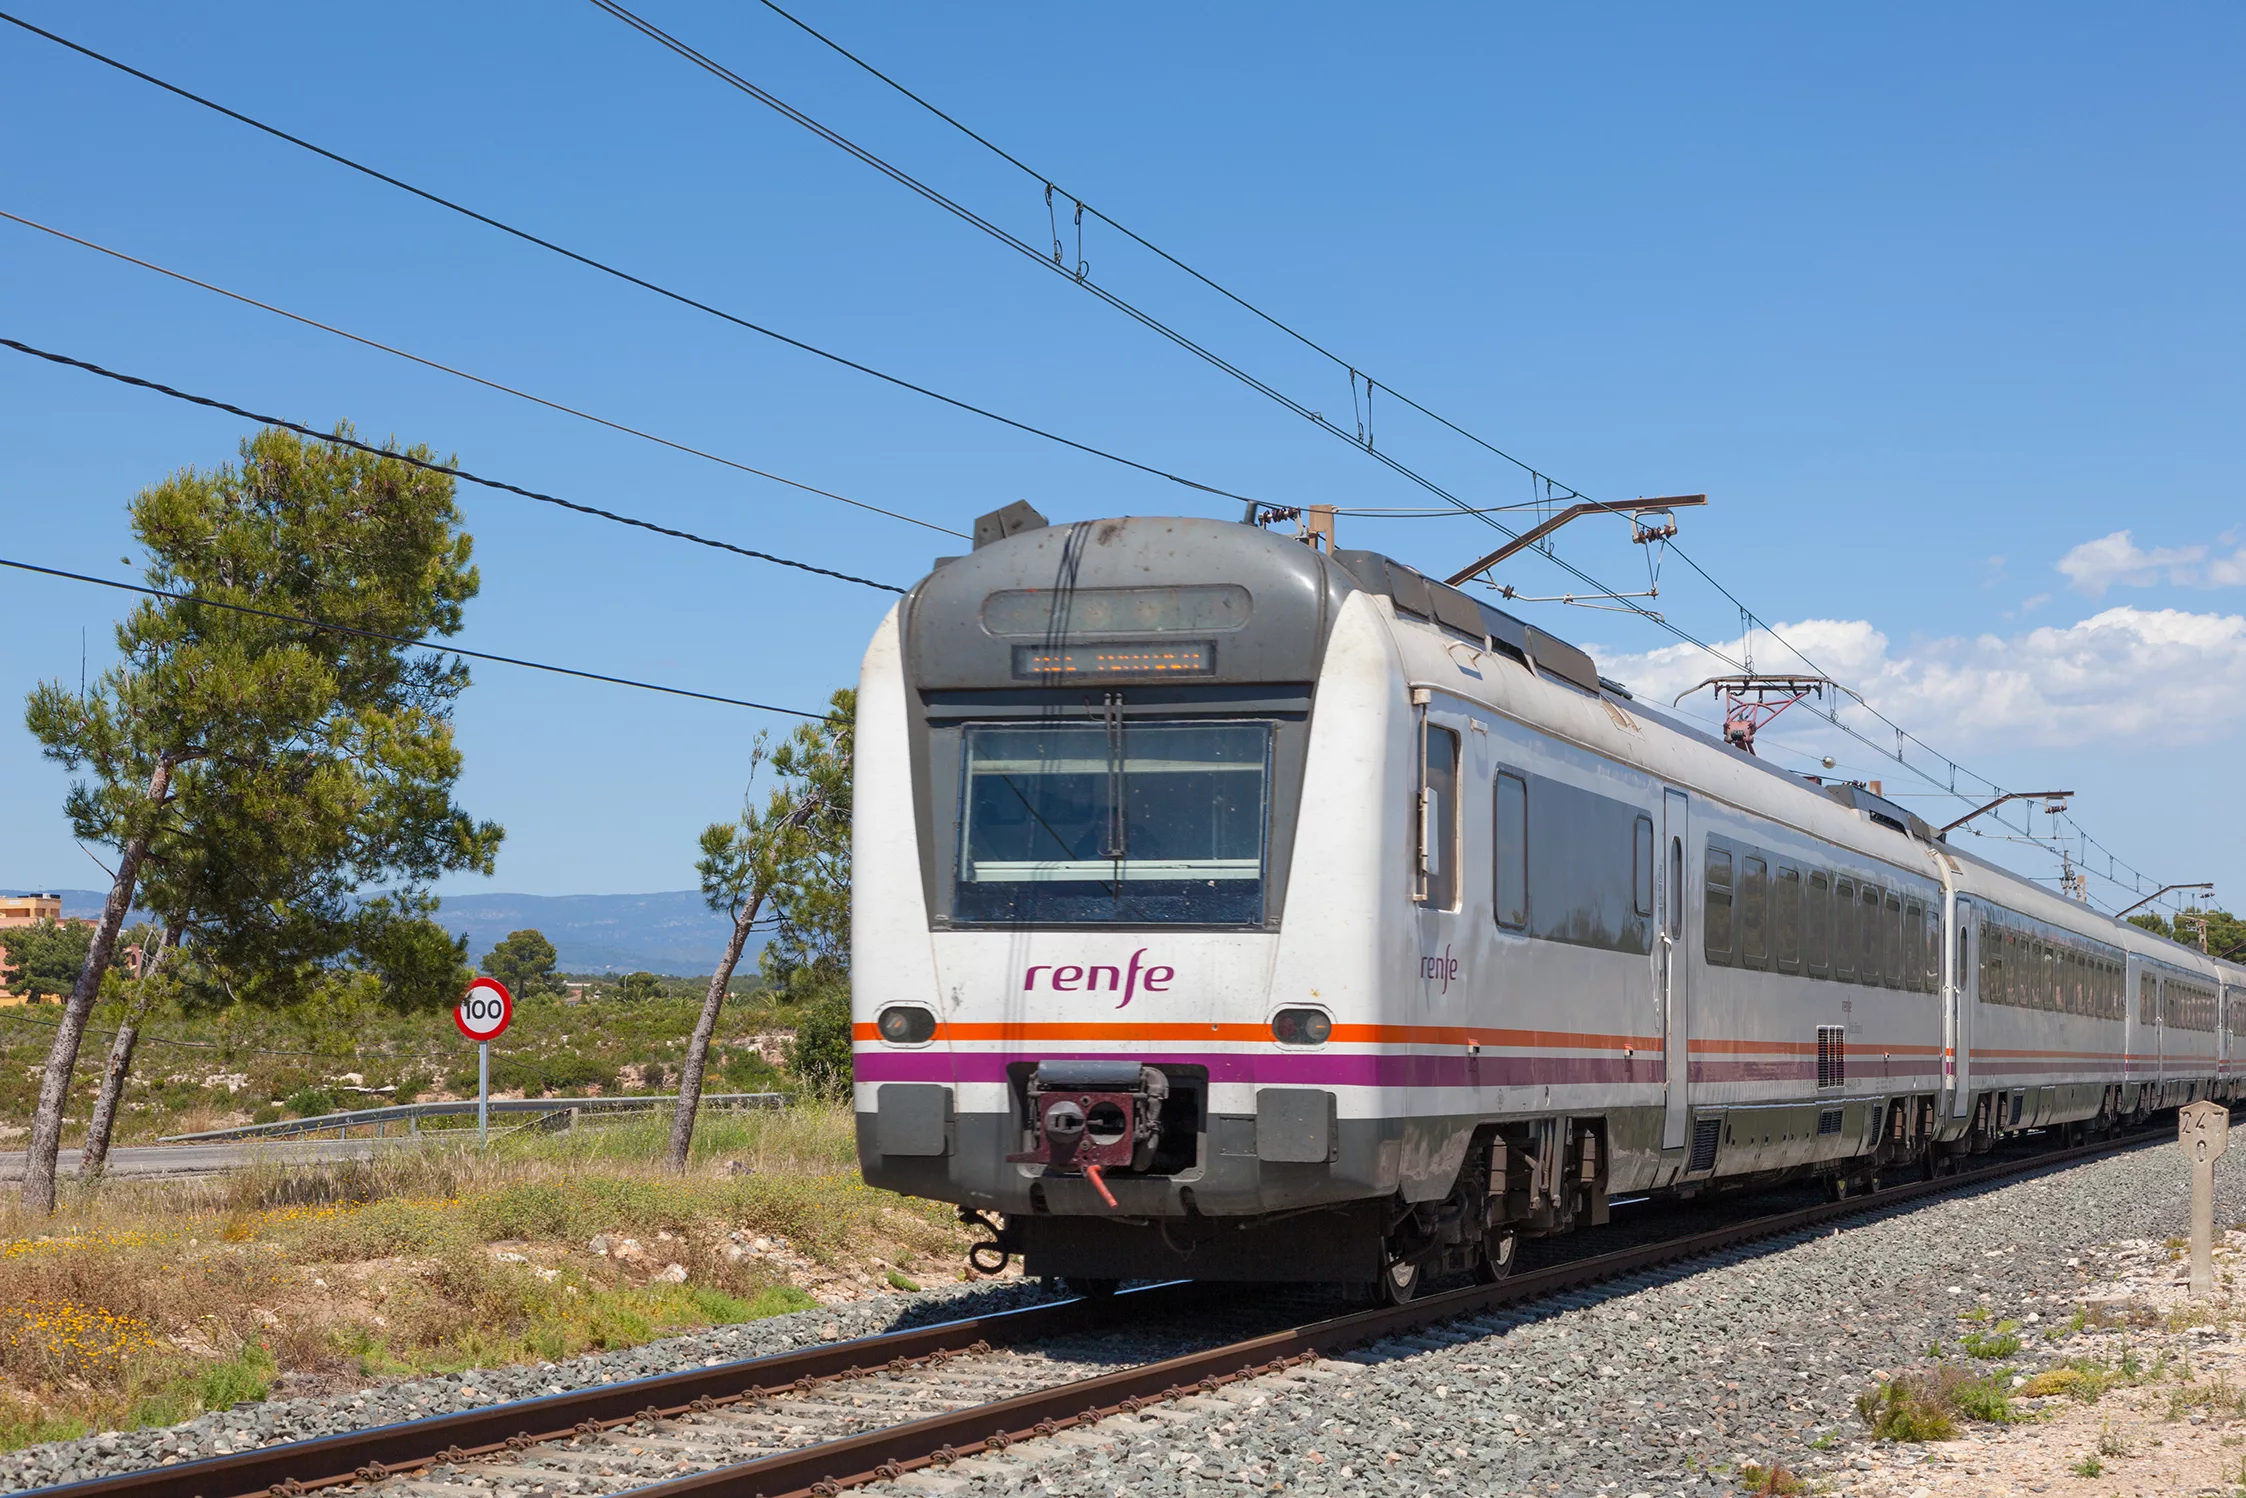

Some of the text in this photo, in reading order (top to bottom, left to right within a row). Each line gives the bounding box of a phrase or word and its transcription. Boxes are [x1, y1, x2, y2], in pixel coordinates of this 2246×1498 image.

[1024, 947, 1175, 1009] renfe
[1420, 943, 1458, 995] renfe
[464, 999, 502, 1020] 100
[2196, 1139, 2207, 1162] 0
